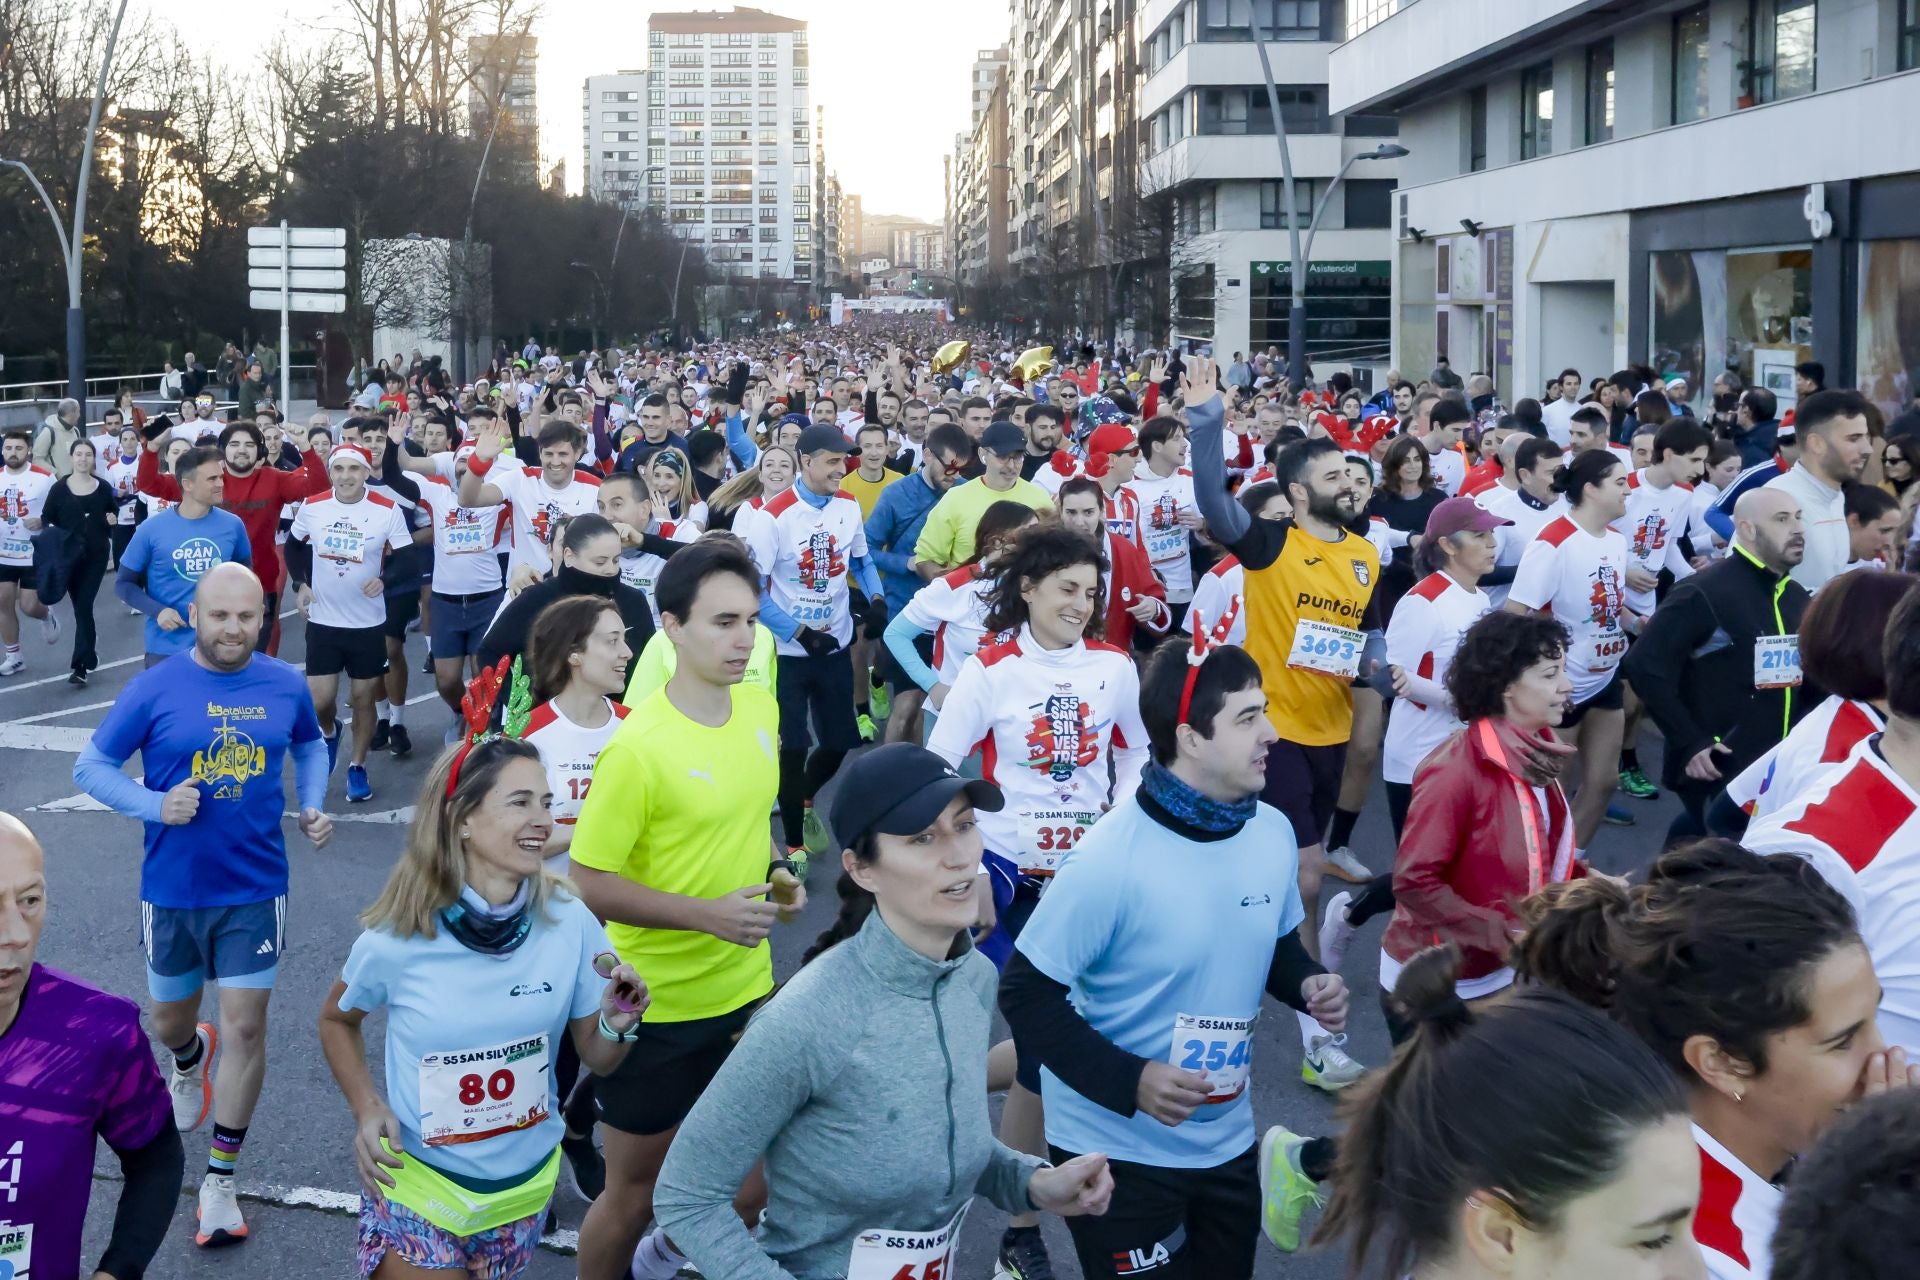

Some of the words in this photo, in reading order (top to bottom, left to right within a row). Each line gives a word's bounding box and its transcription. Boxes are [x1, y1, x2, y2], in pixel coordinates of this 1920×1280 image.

[1309, 262, 1357, 273] Asistencial
[324, 536, 358, 551] 4312
[448, 531, 480, 543] 3964
[813, 540, 829, 550] SAN
[1150, 536, 1181, 552] 3695
[172, 546, 213, 560] GRAN
[813, 549, 829, 560] SIL
[814, 559, 830, 569] VES
[812, 568, 829, 579] TRE
[792, 605, 831, 620] 2280
[1332, 627, 1364, 639] SILVESTRE
[1301, 634, 1355, 660] 3693
[1060, 697, 1079, 710] 55
[1050, 705, 1078, 721] SAN
[1052, 720, 1078, 736] SIL
[1053, 734, 1080, 750] VES
[1051, 750, 1078, 766] TRE
[1046, 811, 1062, 819] SAN
[1198, 1020, 1212, 1029] 55
[1212, 1021, 1233, 1031] SAN
[443, 1056, 459, 1066] 55
[459, 1052, 485, 1064] SAN
[486, 1036, 543, 1060] SILVESTRE
[458, 1068, 516, 1106] 80
[486, 1101, 513, 1112] DOLORES
[886, 1237, 905, 1248] 55
[906, 1238, 935, 1250] SAN
